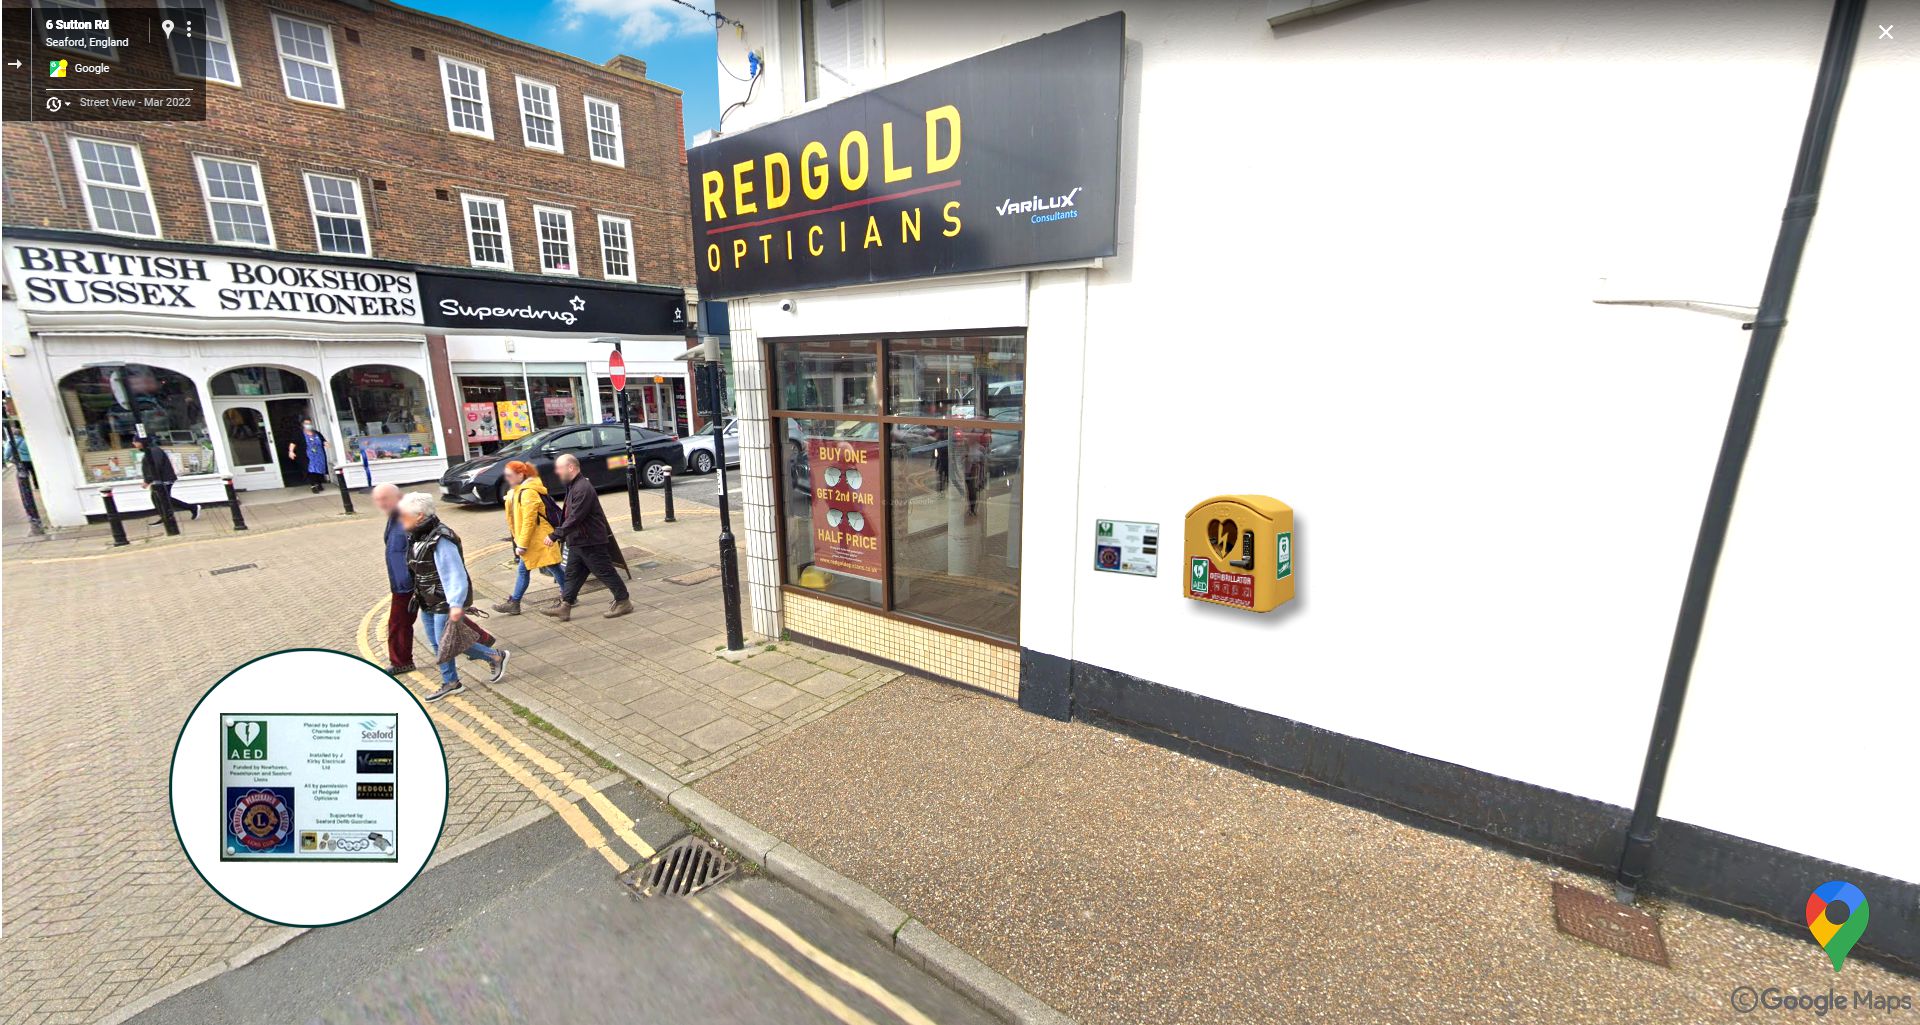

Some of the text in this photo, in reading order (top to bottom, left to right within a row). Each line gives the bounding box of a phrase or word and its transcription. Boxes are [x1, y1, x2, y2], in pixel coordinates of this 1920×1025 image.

[702, 104, 962, 222] REDGOLD
[1031, 209, 1078, 224] Consultants
[707, 200, 963, 272] OPTICIANS
[14, 246, 413, 294] BRITISH BOOKSHOPS
[25, 277, 417, 317] SUSSEX STATIONERS
[439, 299, 578, 326] Superdrug
[820, 447, 867, 464] BUY ONE
[816, 488, 874, 505] GET 2nd PAIR
[818, 528, 843, 544] HALF
[846, 534, 877, 550] PRICE
[1192, 581, 1208, 591] AED
[361, 730, 394, 739] Seaford
[231, 749, 263, 759] AED
[256, 814, 266, 826] L
